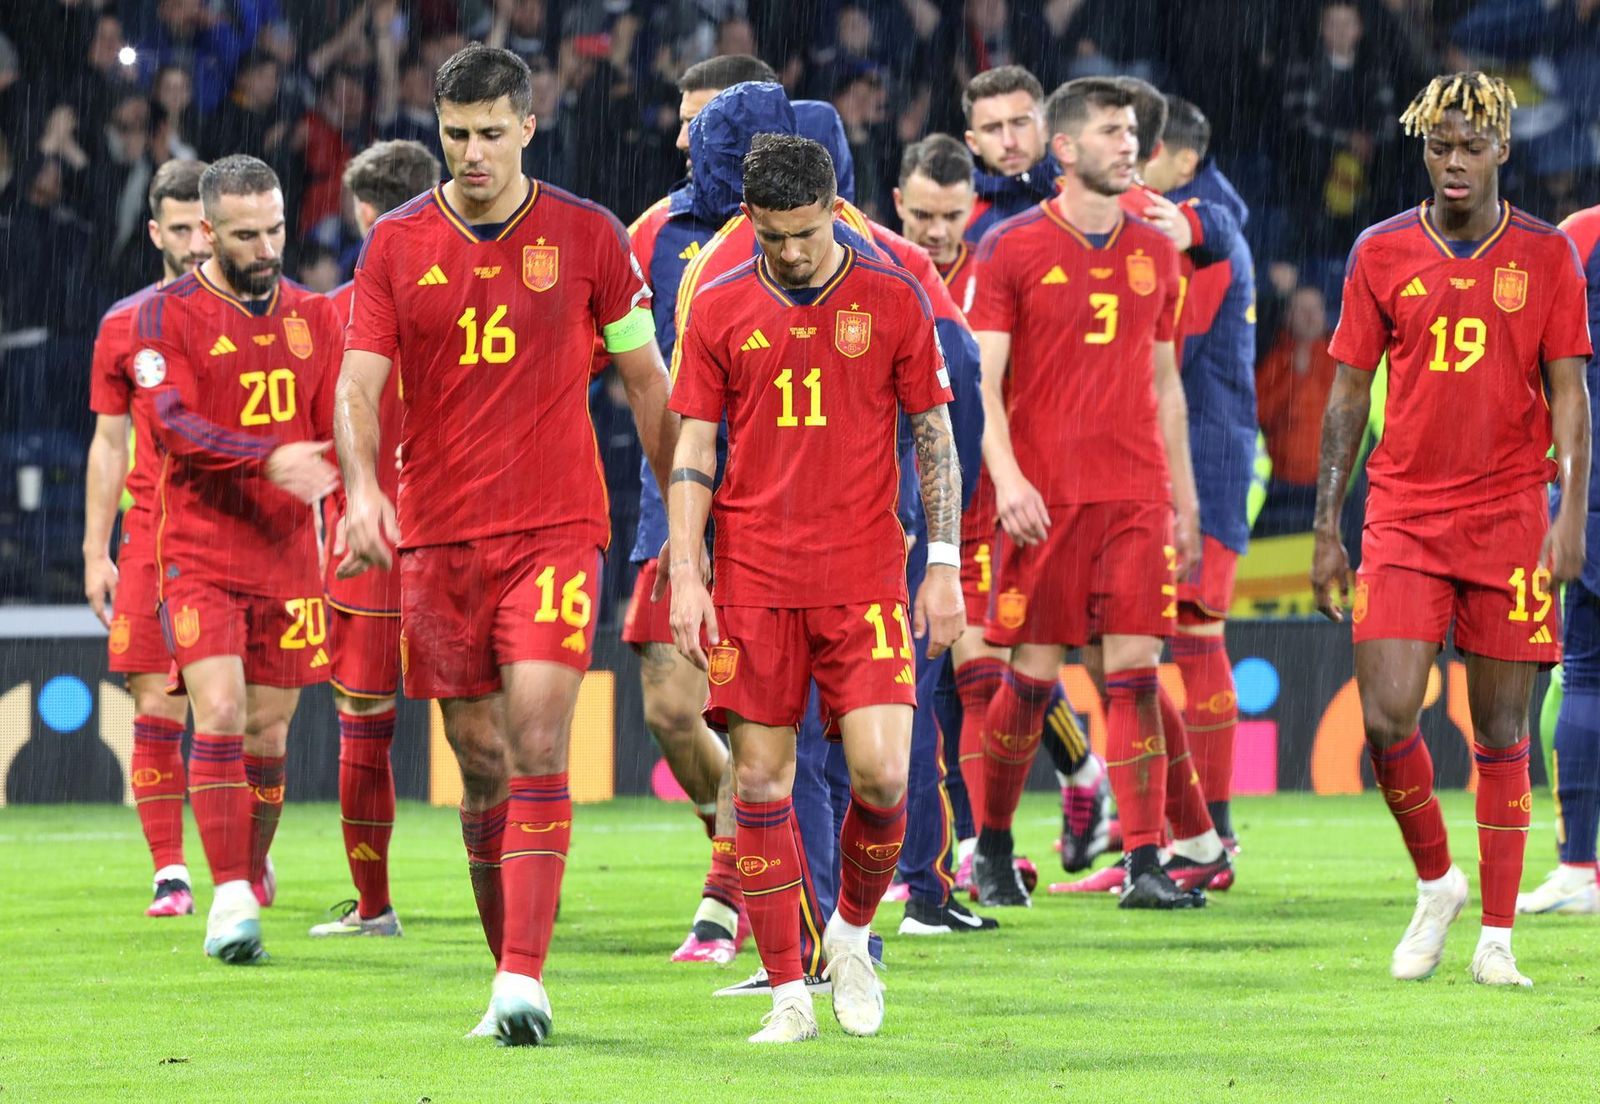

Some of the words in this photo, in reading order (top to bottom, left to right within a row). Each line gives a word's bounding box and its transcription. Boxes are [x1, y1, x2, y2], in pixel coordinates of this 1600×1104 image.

[458, 305, 516, 365] 16
[1084, 293, 1118, 344] 3
[1429, 316, 1487, 372] 19
[240, 368, 296, 426] 20
[773, 368, 827, 426] 11
[534, 566, 591, 629] 16
[1508, 567, 1552, 622] 19
[280, 598, 326, 649] 20
[864, 603, 912, 660] 11
